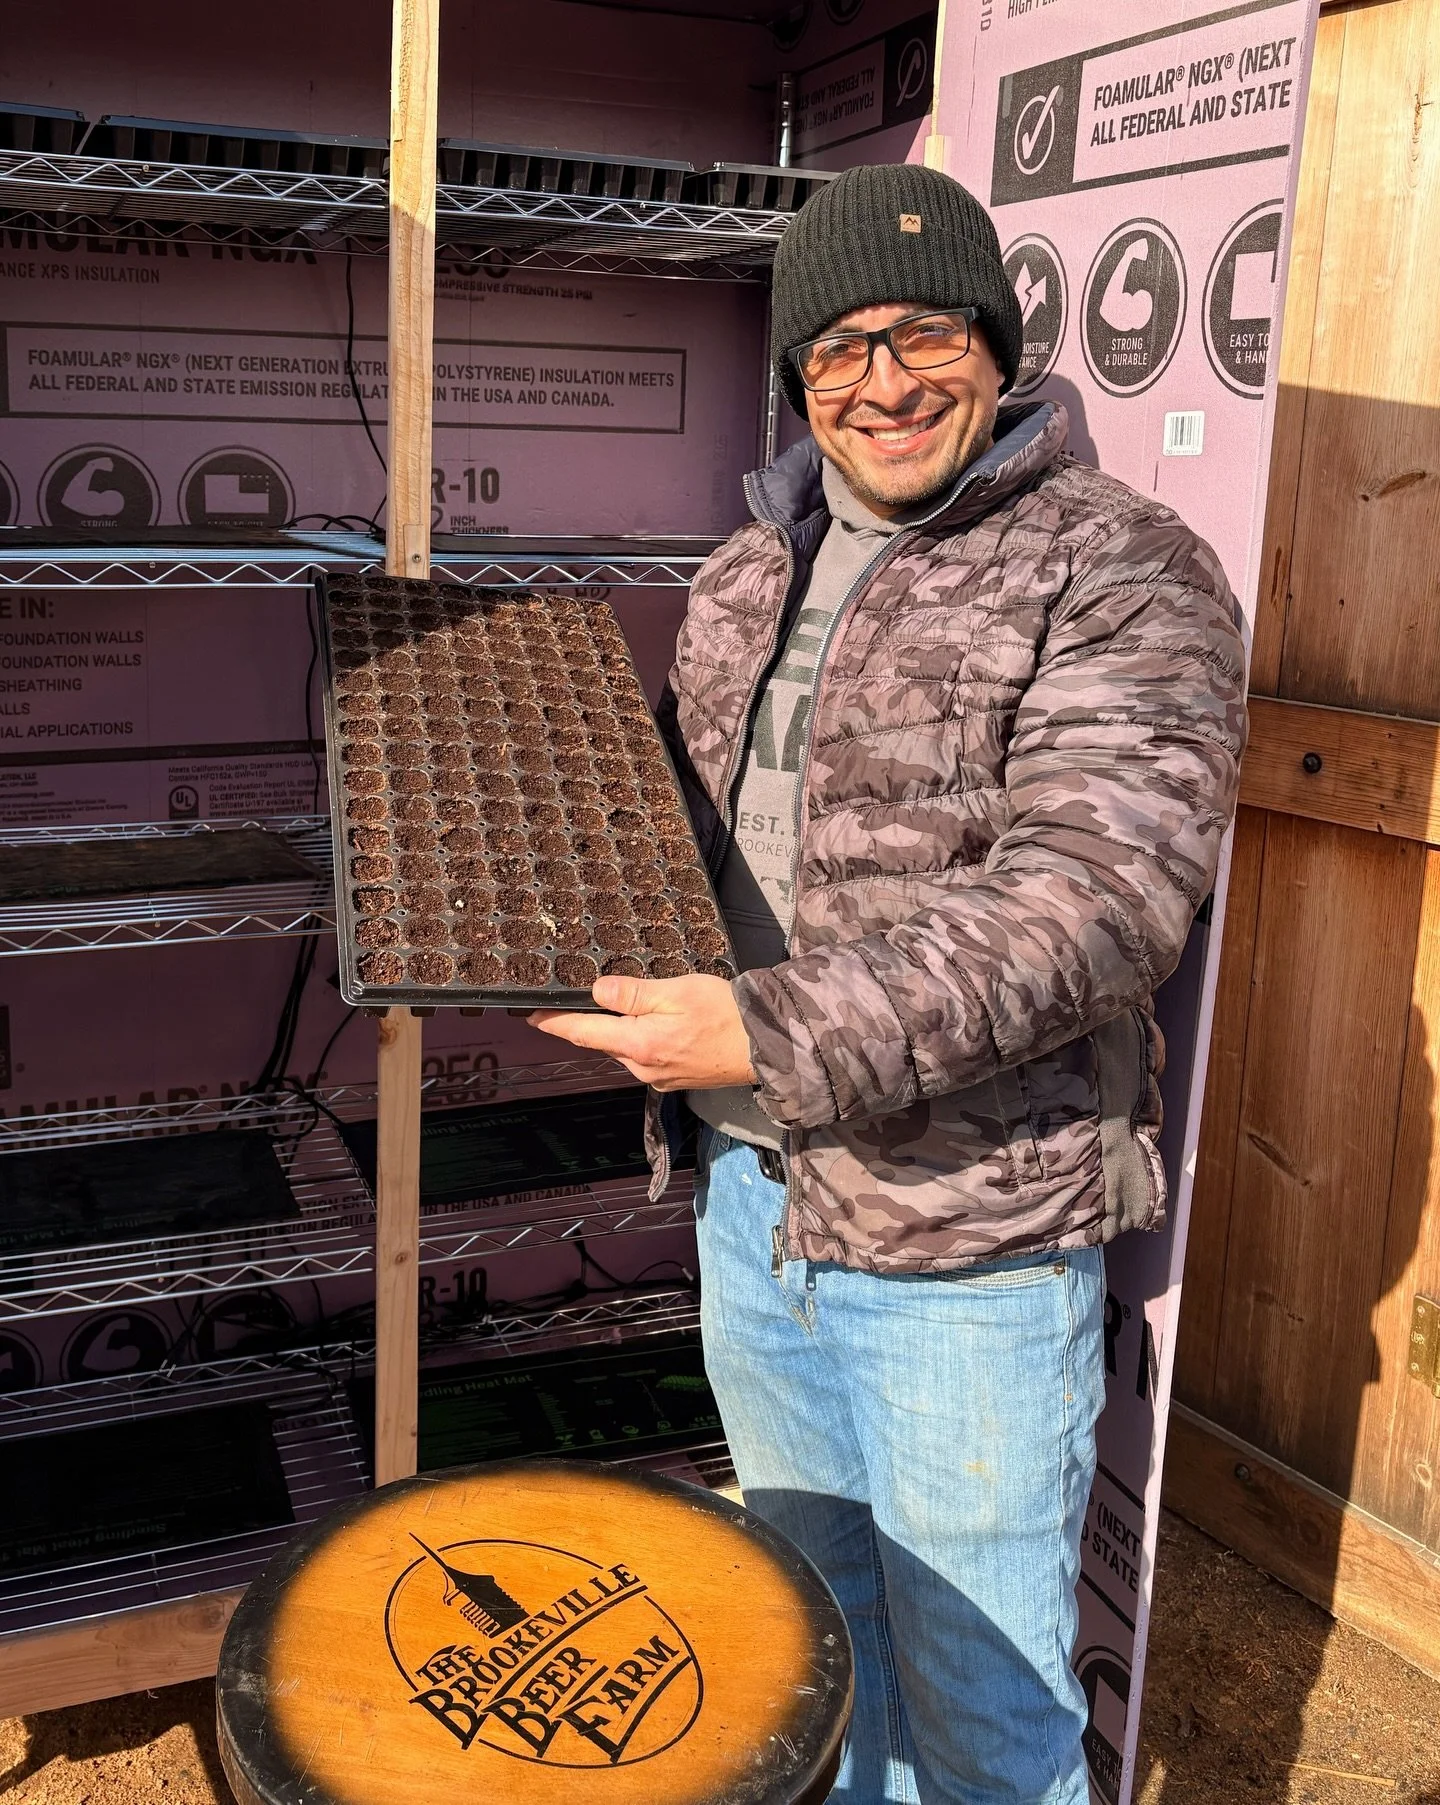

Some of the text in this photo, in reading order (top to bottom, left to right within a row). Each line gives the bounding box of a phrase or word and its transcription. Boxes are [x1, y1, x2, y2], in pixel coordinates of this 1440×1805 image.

[1239, 37, 1297, 83] (NEXT
[828, 72, 860, 100] FEDERAL
[1090, 79, 1293, 147] ALL FEDERAL AND STATE
[41, 263, 70, 280] XPS
[75, 265, 161, 285] INSULATION
[502, 281, 559, 298] STRENGTH
[1111, 337, 1143, 351] STRONG
[1229, 333, 1255, 348] EASY
[185, 354, 234, 374] (NEXT
[238, 355, 340, 375] GENERATION
[1104, 352, 1148, 366] & DURABLE
[1235, 350, 1241, 364] &
[28, 374, 61, 391] ALL
[65, 375, 139, 393] FEDERAL
[143, 377, 178, 394] AND
[183, 378, 236, 395] STATE
[240, 380, 317, 398] EMISSION
[433, 364, 675, 388] OLYSTYRENE) INSULATION MEETS
[451, 387, 480, 403] THE
[484, 389, 514, 404] USA
[517, 390, 548, 406] AND
[551, 391, 616, 408] CANADA.
[432, 467, 500, 505] R-10
[450, 515, 476, 527] INCH
[20, 597, 55, 620] IN:
[95, 630, 145, 644] WALLS
[0, 653, 142, 670] OUNDATION WALLS
[0, 677, 83, 693] SHEATHING
[27, 722, 134, 738] APPLICATIONS
[168, 774, 199, 782] Contains
[191, 764, 224, 773] California
[225, 763, 249, 772] Quality
[739, 811, 785, 836] EST.
[472, 1197, 500, 1210] USA
[504, 1193, 532, 1205] AND
[1097, 1501, 1141, 1558] (NEXT
[1092, 1531, 1139, 1594] STATE
[409, 1563, 640, 1750] BROOKEVILLE
[416, 1645, 485, 1687] THE
[481, 1646, 597, 1758] BEER
[557, 1635, 680, 1765] FARM
